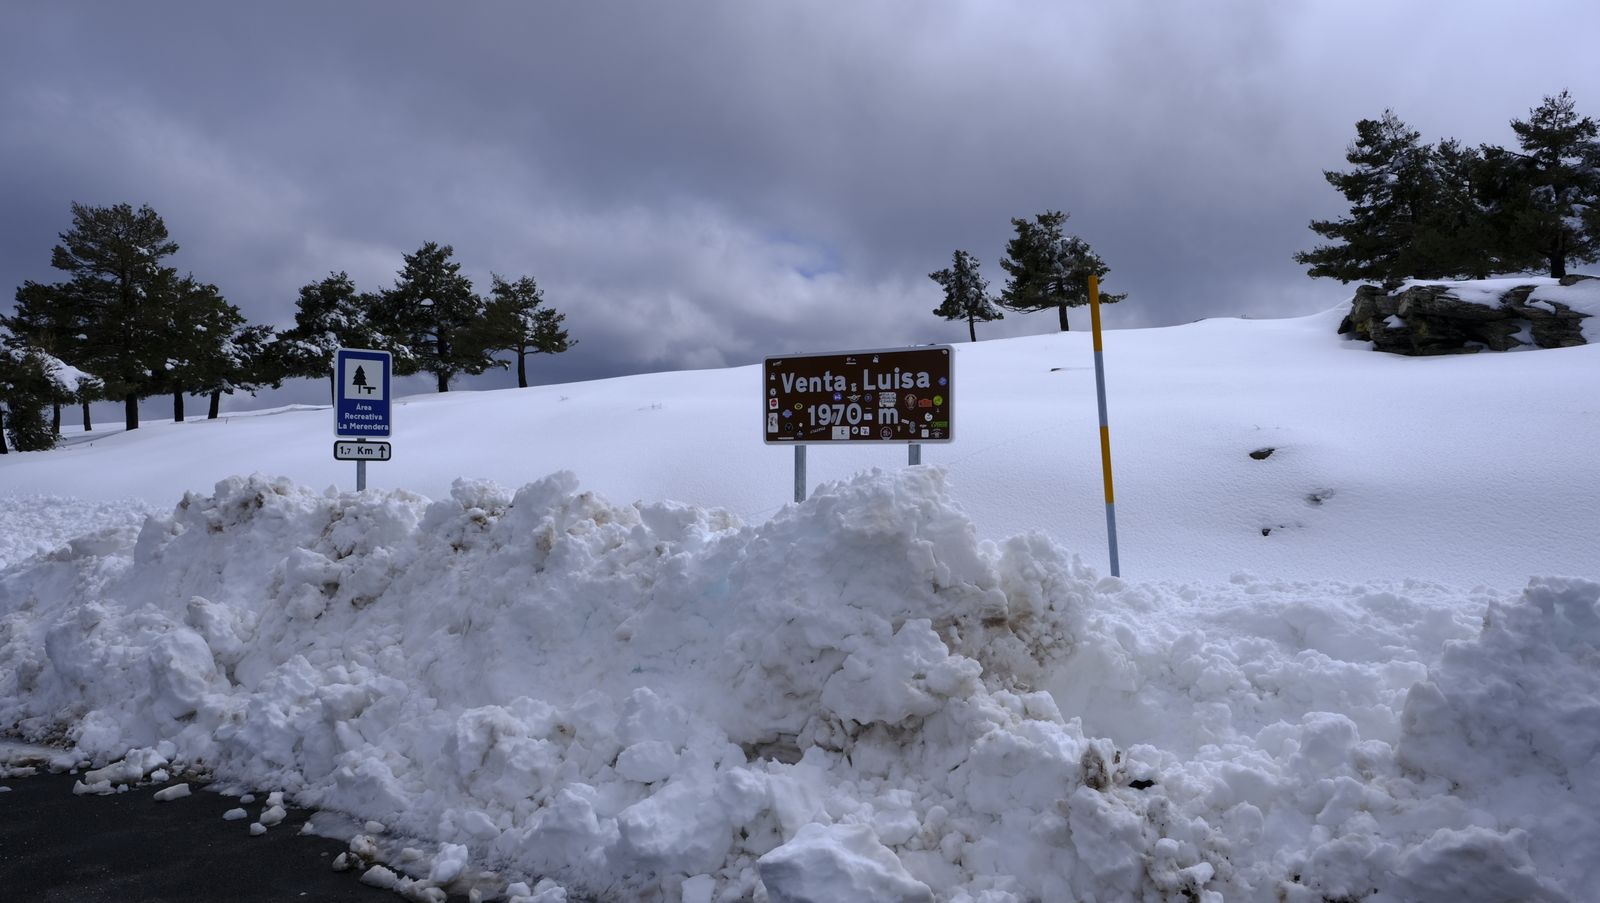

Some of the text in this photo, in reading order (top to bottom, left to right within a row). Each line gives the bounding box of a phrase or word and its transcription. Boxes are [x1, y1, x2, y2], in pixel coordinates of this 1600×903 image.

[781, 367, 930, 393] Venta Luisa
[808, 402, 899, 426] 1970 m
[357, 446, 373, 455] Km
